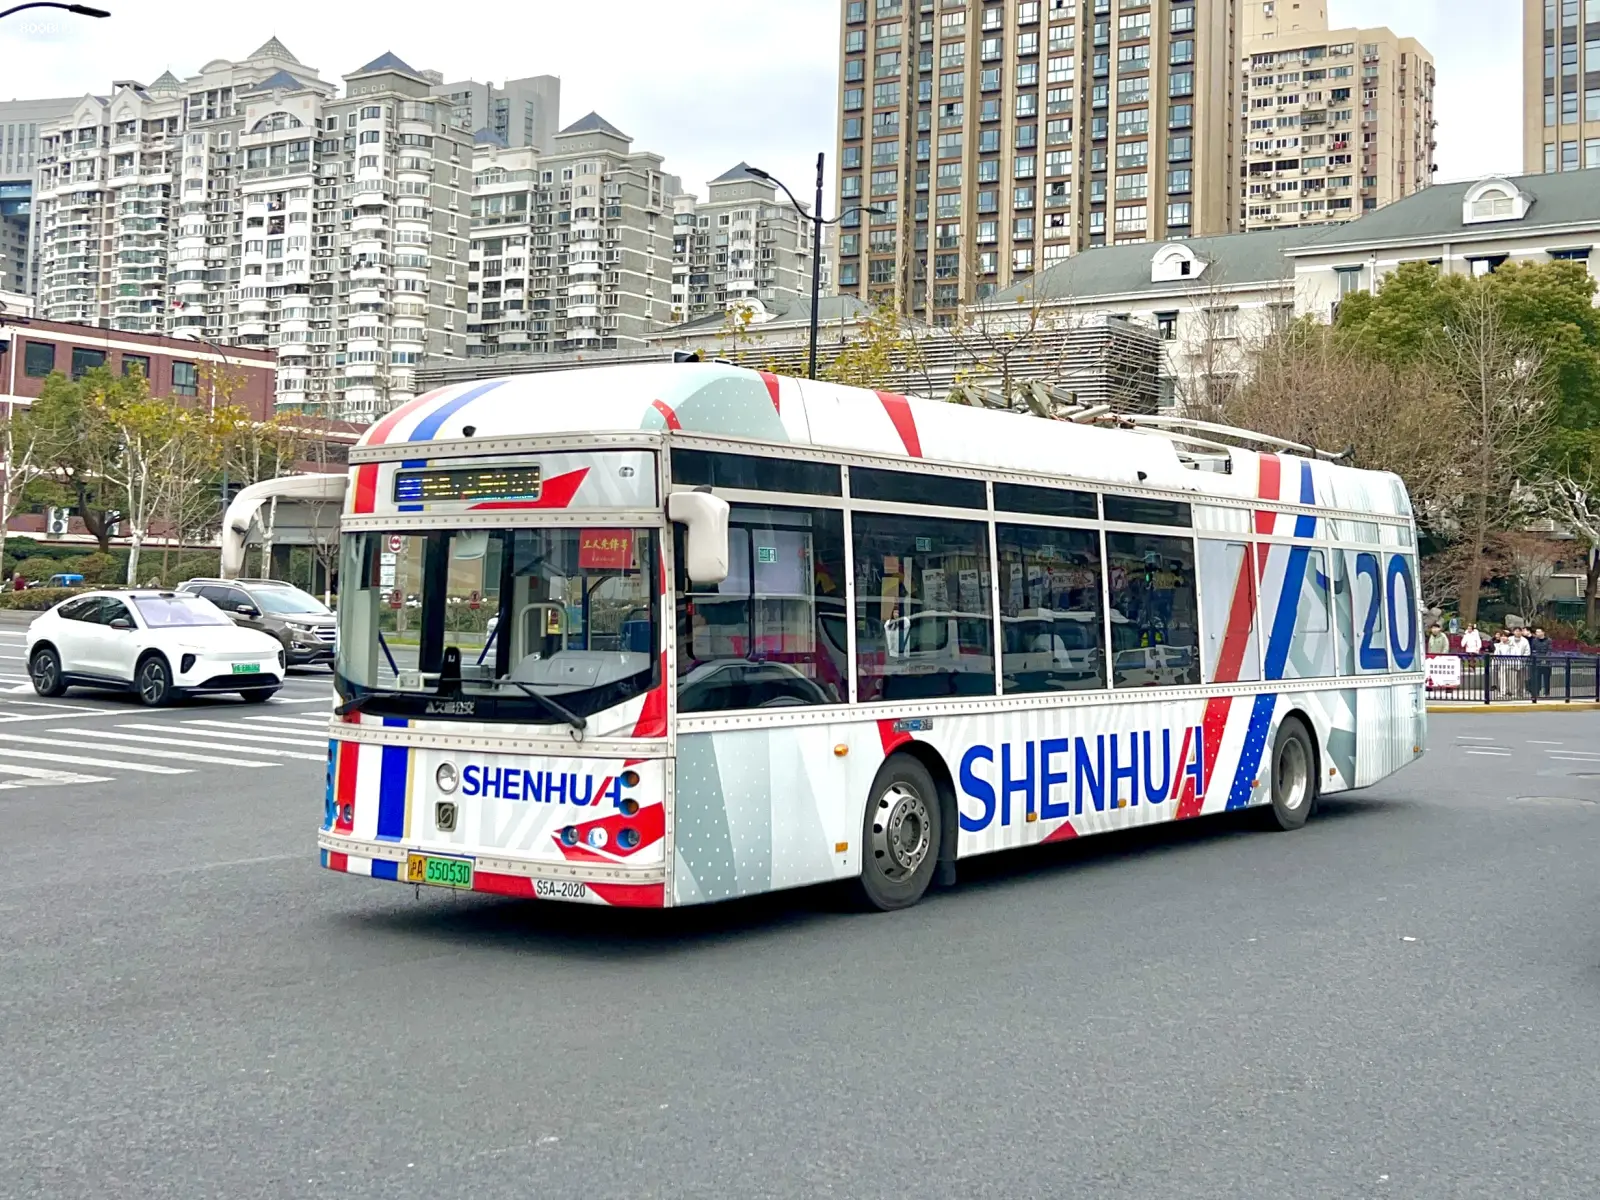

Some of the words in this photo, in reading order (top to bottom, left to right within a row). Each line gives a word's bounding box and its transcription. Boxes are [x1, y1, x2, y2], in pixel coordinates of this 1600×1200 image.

[1356, 553, 1415, 669] 20
[462, 765, 622, 807] SHENHUA
[959, 725, 1204, 832] SHENHUA
[537, 880, 586, 898] S5A-2020
